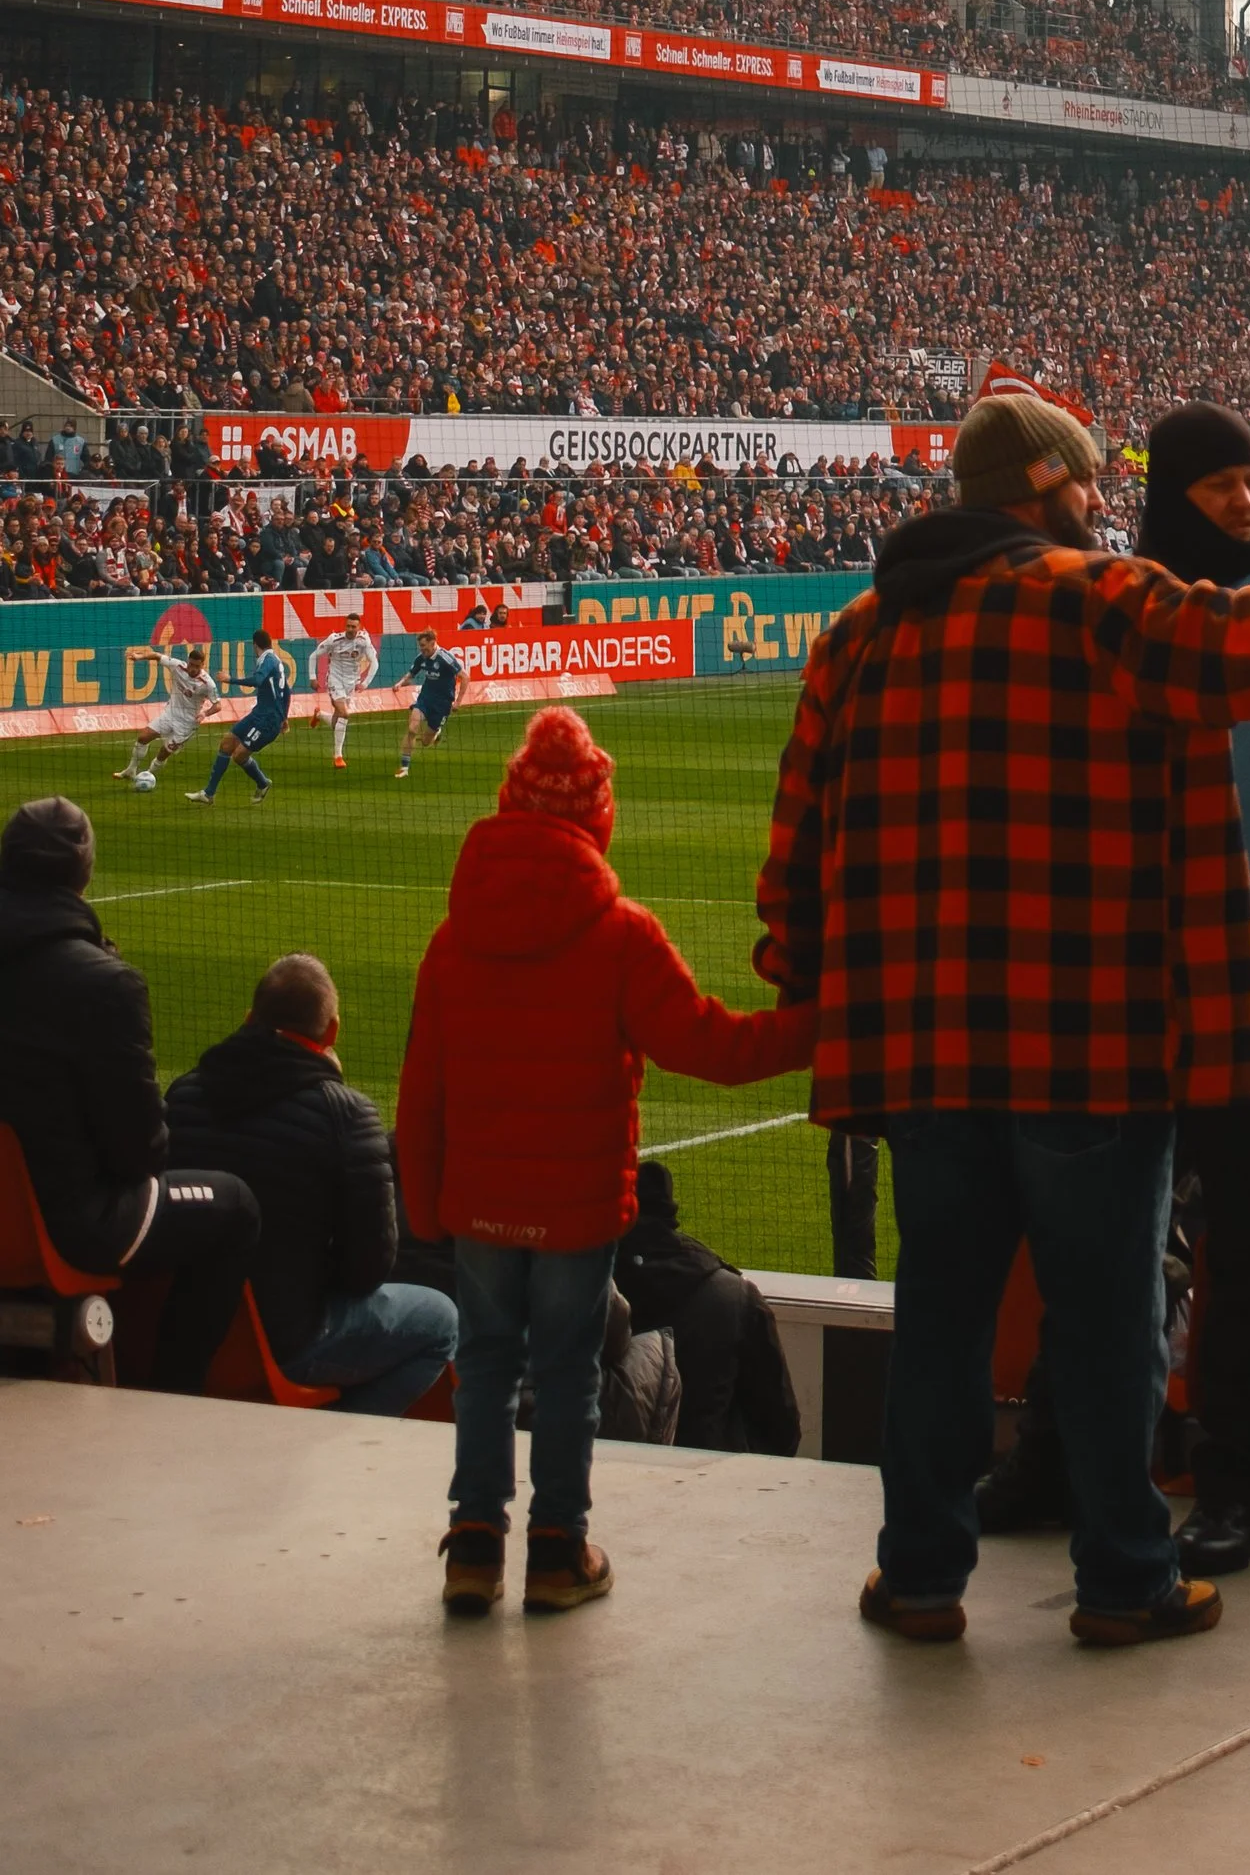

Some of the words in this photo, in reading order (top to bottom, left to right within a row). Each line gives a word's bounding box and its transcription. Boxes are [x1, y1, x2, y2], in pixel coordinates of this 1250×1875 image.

[381, 5, 429, 31] EXPRESS.
[491, 22, 502, 38] Wo
[504, 24, 531, 41] Fußball
[532, 28, 555, 44] immer
[556, 31, 590, 51] Heimspiel
[592, 37, 605, 51] hat.
[656, 43, 689, 66] Schnell.
[691, 47, 733, 71] Schneller.
[736, 53, 774, 77] EXPRESS.
[823, 67, 833, 81] Wo
[834, 69, 855, 85] Fußball
[856, 73, 875, 87] immer
[1064, 99, 1163, 130] RheinEnergieSTADION
[928, 359, 966, 375] SILBER
[549, 429, 778, 463] GEISSBOCKPARTNER
[452, 637, 562, 676] SPÜRBAR
[565, 634, 676, 671] ANDERS.
